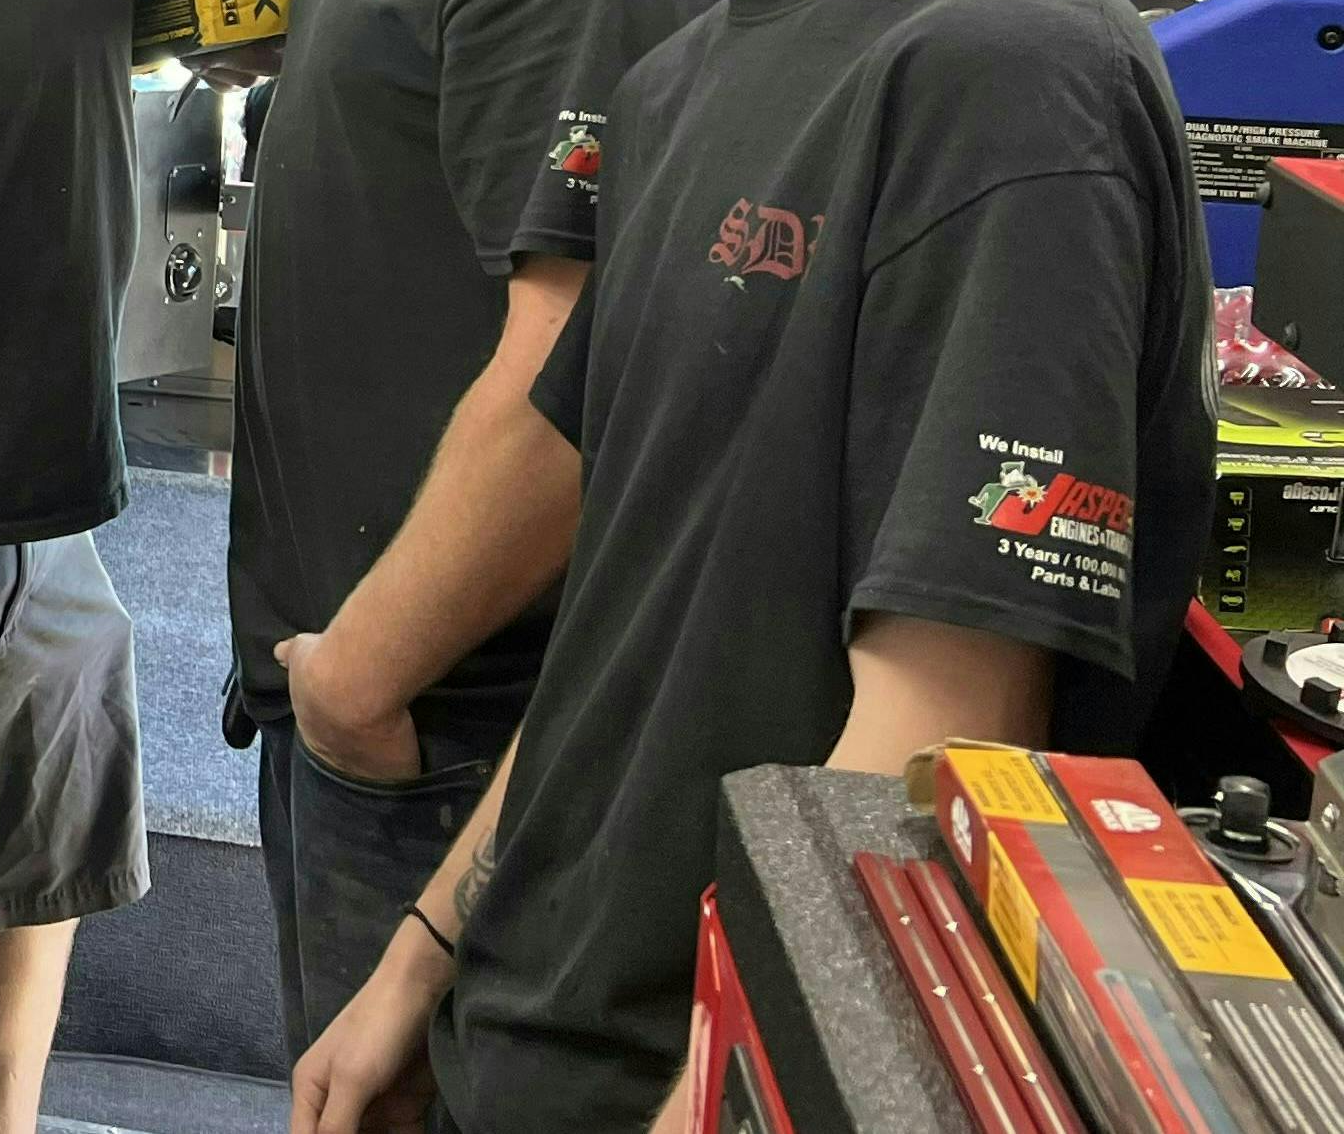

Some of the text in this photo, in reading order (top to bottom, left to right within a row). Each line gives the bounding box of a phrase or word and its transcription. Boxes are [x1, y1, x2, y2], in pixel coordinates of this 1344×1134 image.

[559, 109, 577, 123] We
[1185, 122, 1211, 133] DUAL
[1268, 126, 1321, 139] PRESSURE
[1245, 135, 1281, 146] SMOKE
[1283, 137, 1329, 149] MACHINE
[566, 177, 576, 190] 3
[978, 433, 1065, 466] We Install
[1050, 516, 1100, 547] ENGINES
[998, 538, 1011, 555] 3
[1014, 540, 1061, 566] Years
[1063, 552, 1072, 567] /
[1030, 565, 1075, 588] Parts
[1078, 575, 1091, 591] &
